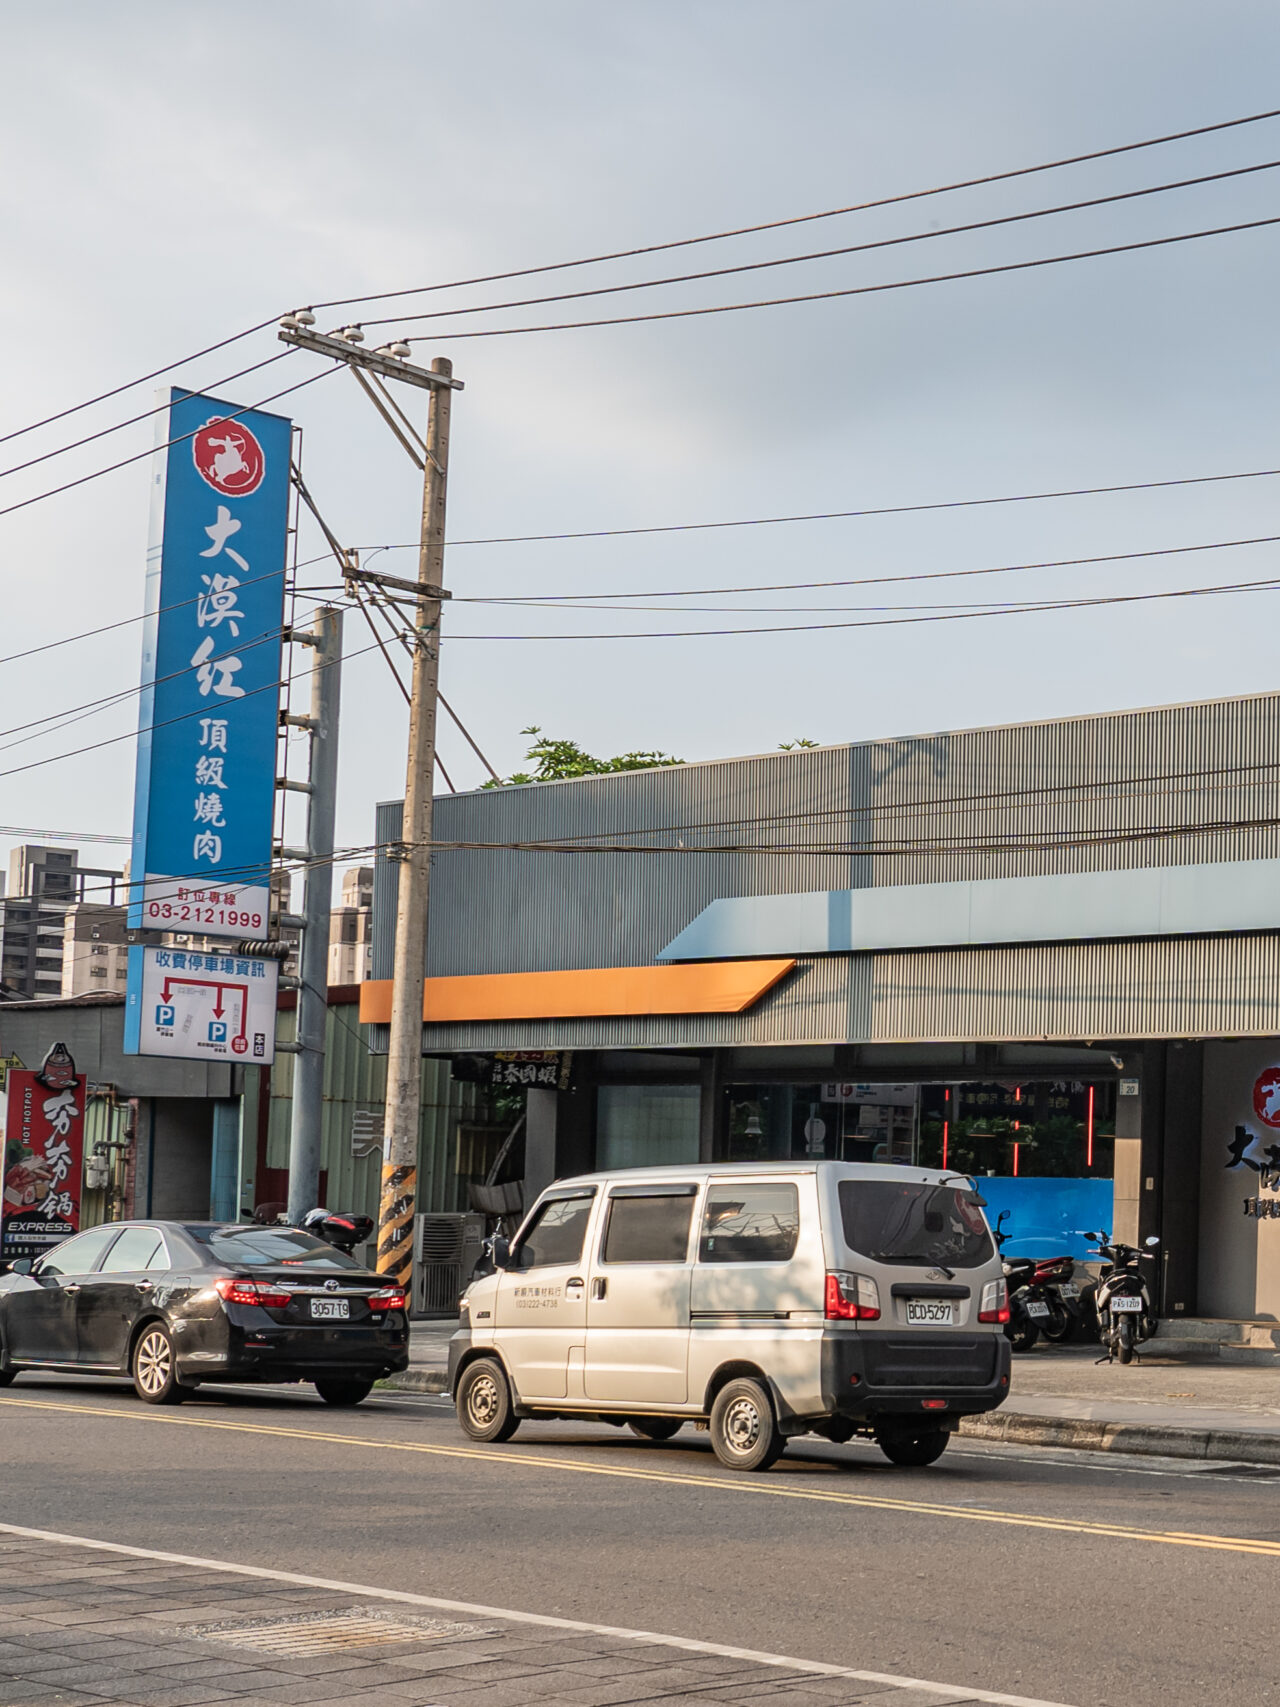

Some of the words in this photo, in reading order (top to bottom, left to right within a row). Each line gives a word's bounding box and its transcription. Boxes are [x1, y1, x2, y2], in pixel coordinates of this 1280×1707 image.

[177, 887, 236, 906] 訂位專線
[149, 902, 262, 929] 03-2121999
[155, 951, 266, 979] 收費停車場資訊
[159, 1006, 172, 1024] P
[212, 1023, 224, 1041] P
[255, 1034, 265, 1055] 本店
[503, 1064, 557, 1085] 泰國蝦
[1126, 1085, 1135, 1093] 20
[23, 1087, 33, 1122] HOTPOT
[22, 1126, 31, 1144] HOT
[8, 1222, 73, 1232] EXPRESS
[908, 1304, 951, 1320] BCD-5297
